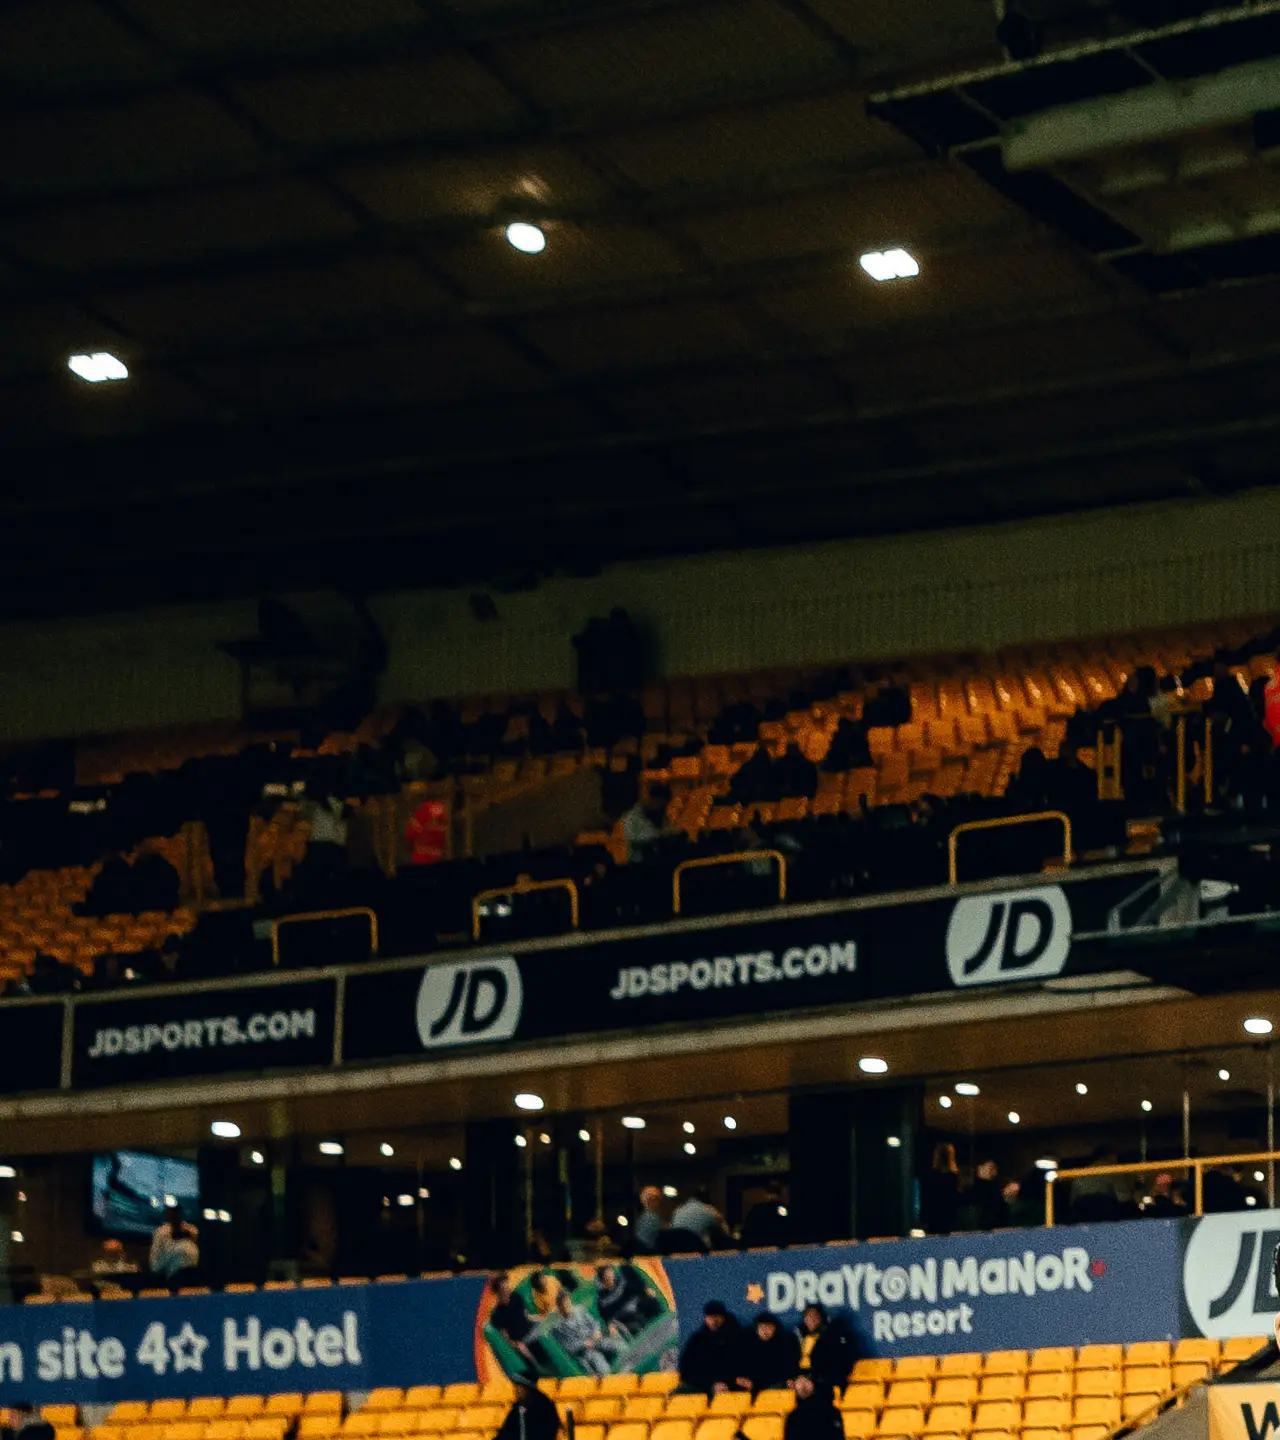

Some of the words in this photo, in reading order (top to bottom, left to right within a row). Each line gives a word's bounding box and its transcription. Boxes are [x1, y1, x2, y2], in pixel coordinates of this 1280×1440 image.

[609, 940, 858, 1000] JDSPORTS.COM
[965, 901, 1053, 975] JD
[88, 1008, 317, 1058] JDSPORTS.COM
[431, 969, 507, 1037] JD
[37, 1326, 127, 1382] site
[137, 1321, 170, 1376] 4
[223, 1310, 363, 1372] Hotel
[873, 1303, 973, 1344] Resort
